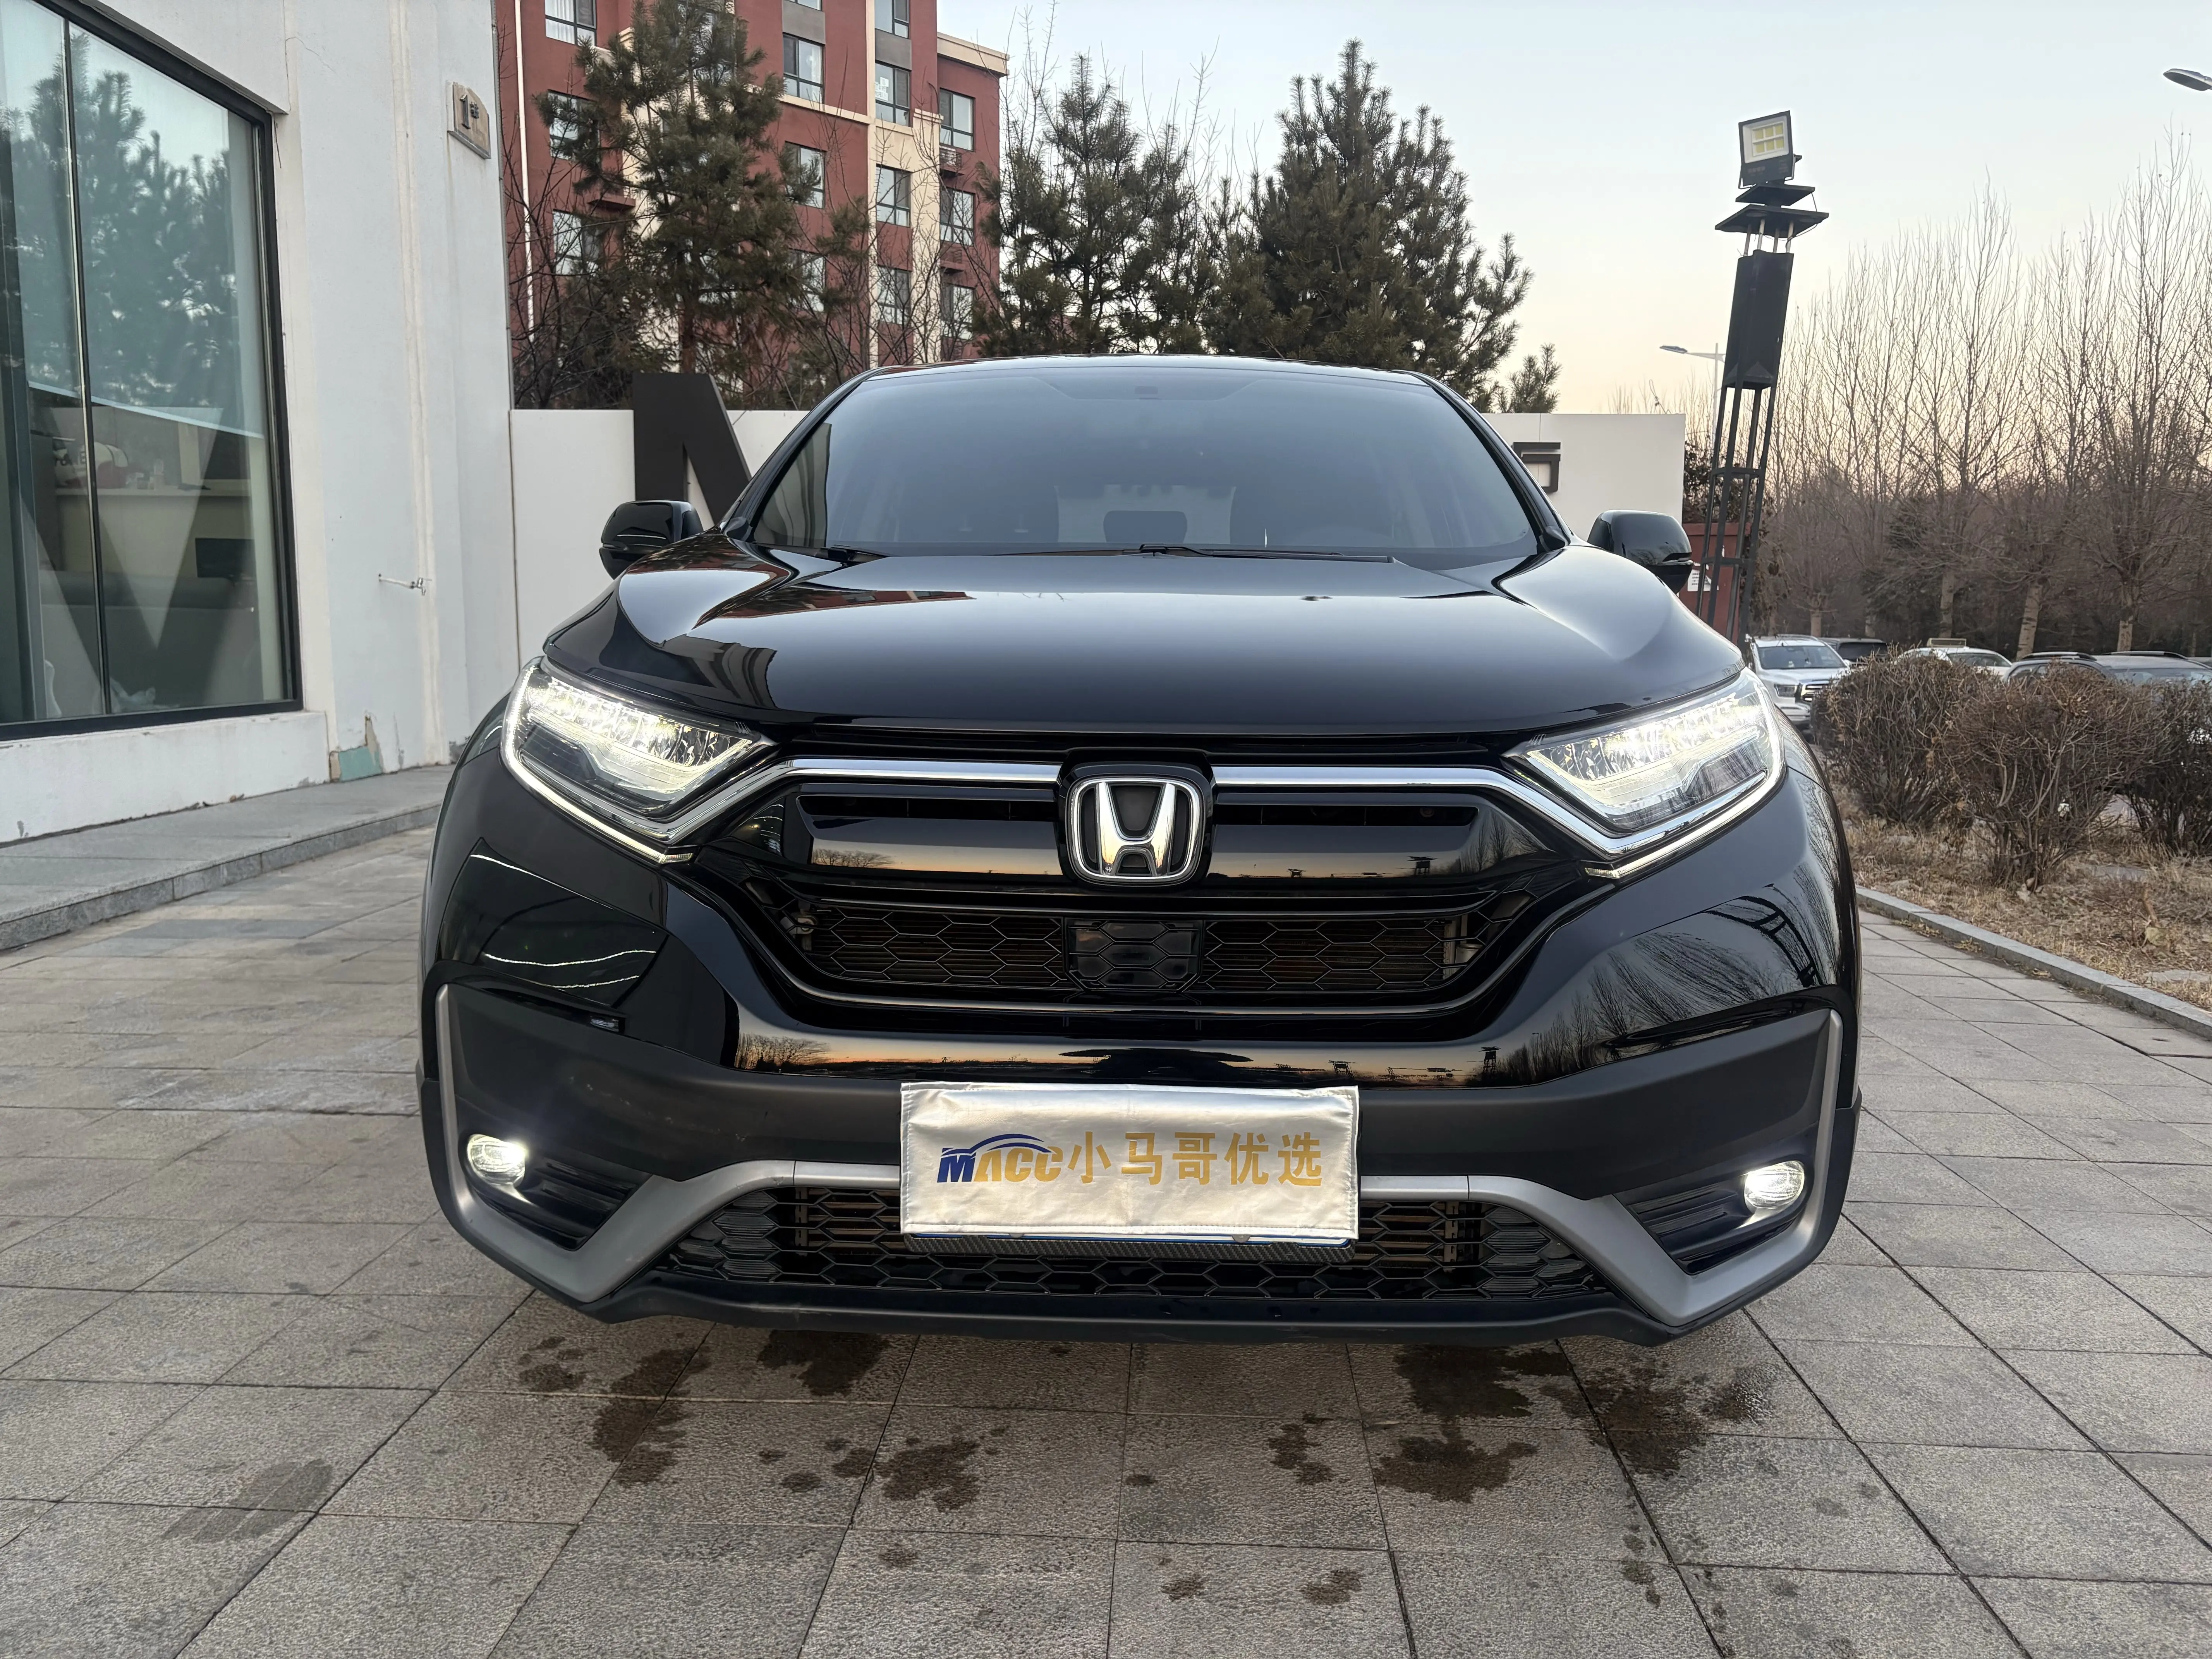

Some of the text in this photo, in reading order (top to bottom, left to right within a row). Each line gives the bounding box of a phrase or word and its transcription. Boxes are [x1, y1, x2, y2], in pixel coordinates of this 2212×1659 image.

[936, 1130, 1323, 1187] MACC 小马哥优选
